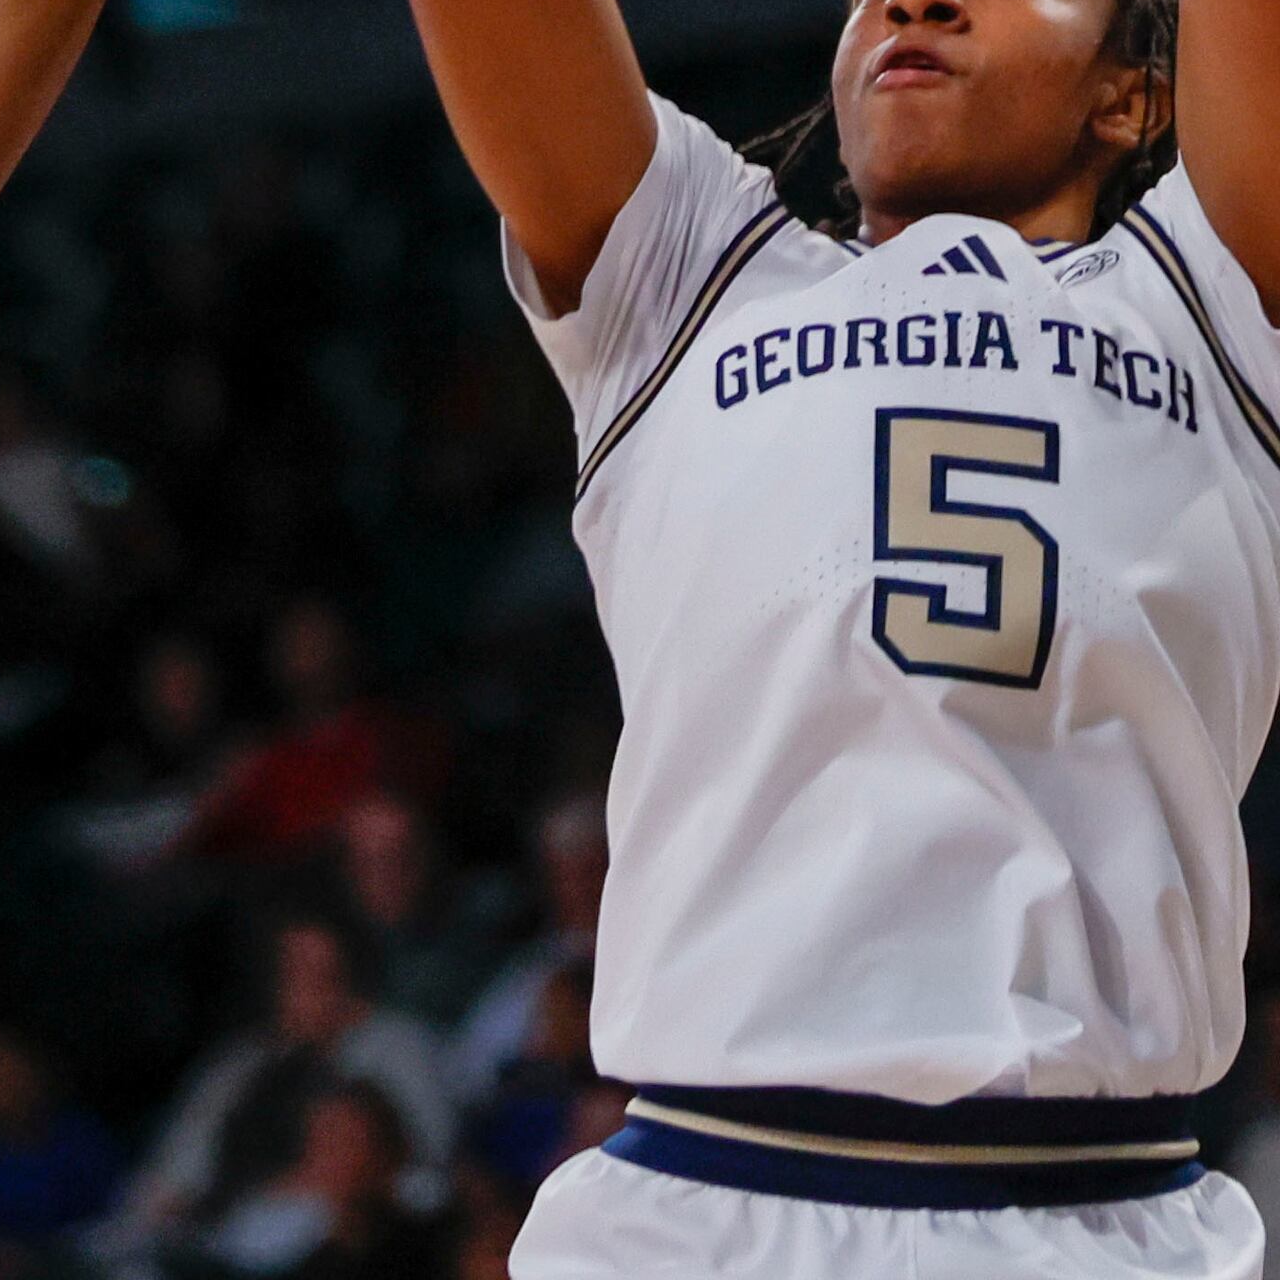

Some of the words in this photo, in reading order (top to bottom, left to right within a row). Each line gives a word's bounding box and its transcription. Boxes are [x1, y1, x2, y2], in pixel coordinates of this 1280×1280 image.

[714, 309, 1019, 410] GEORGIA
[1040, 319, 1199, 434] TECH
[872, 407, 1060, 690] 5
